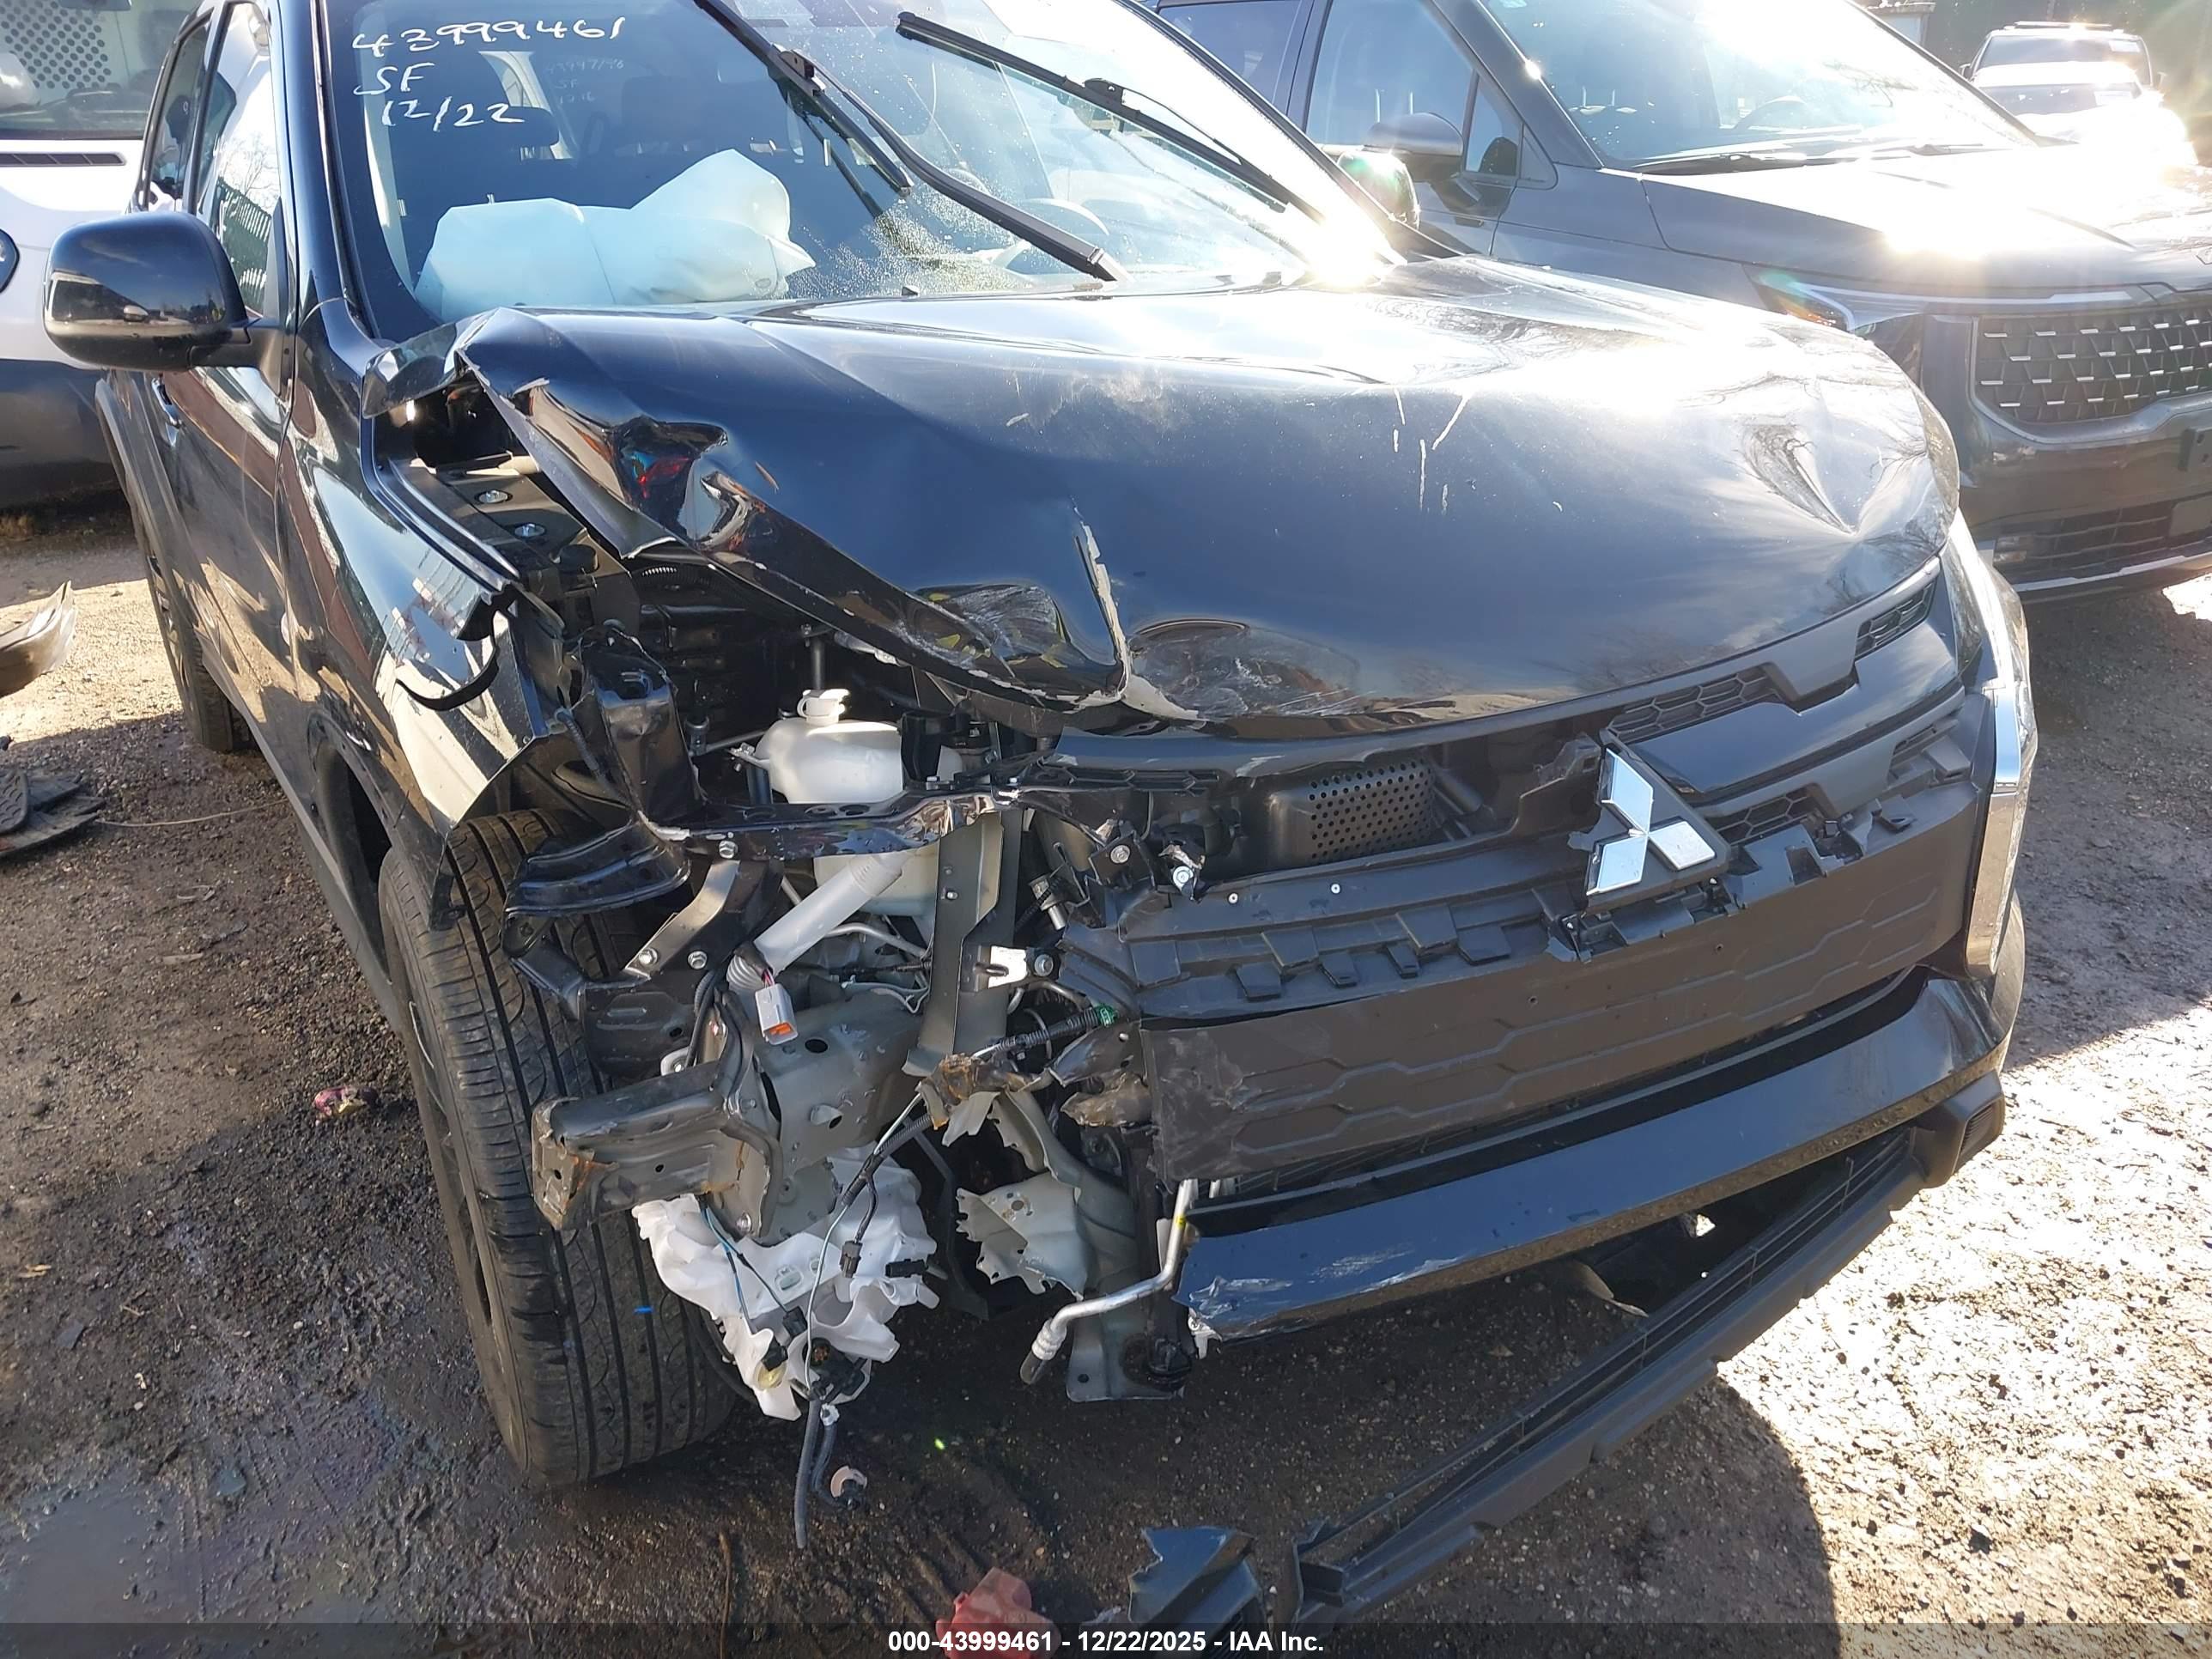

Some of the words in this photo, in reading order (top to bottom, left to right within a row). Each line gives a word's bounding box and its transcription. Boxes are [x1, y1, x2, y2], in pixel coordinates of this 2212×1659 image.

[352, 17, 625, 58] 43999461
[353, 63, 434, 95] SF
[381, 96, 525, 131] 12/22
